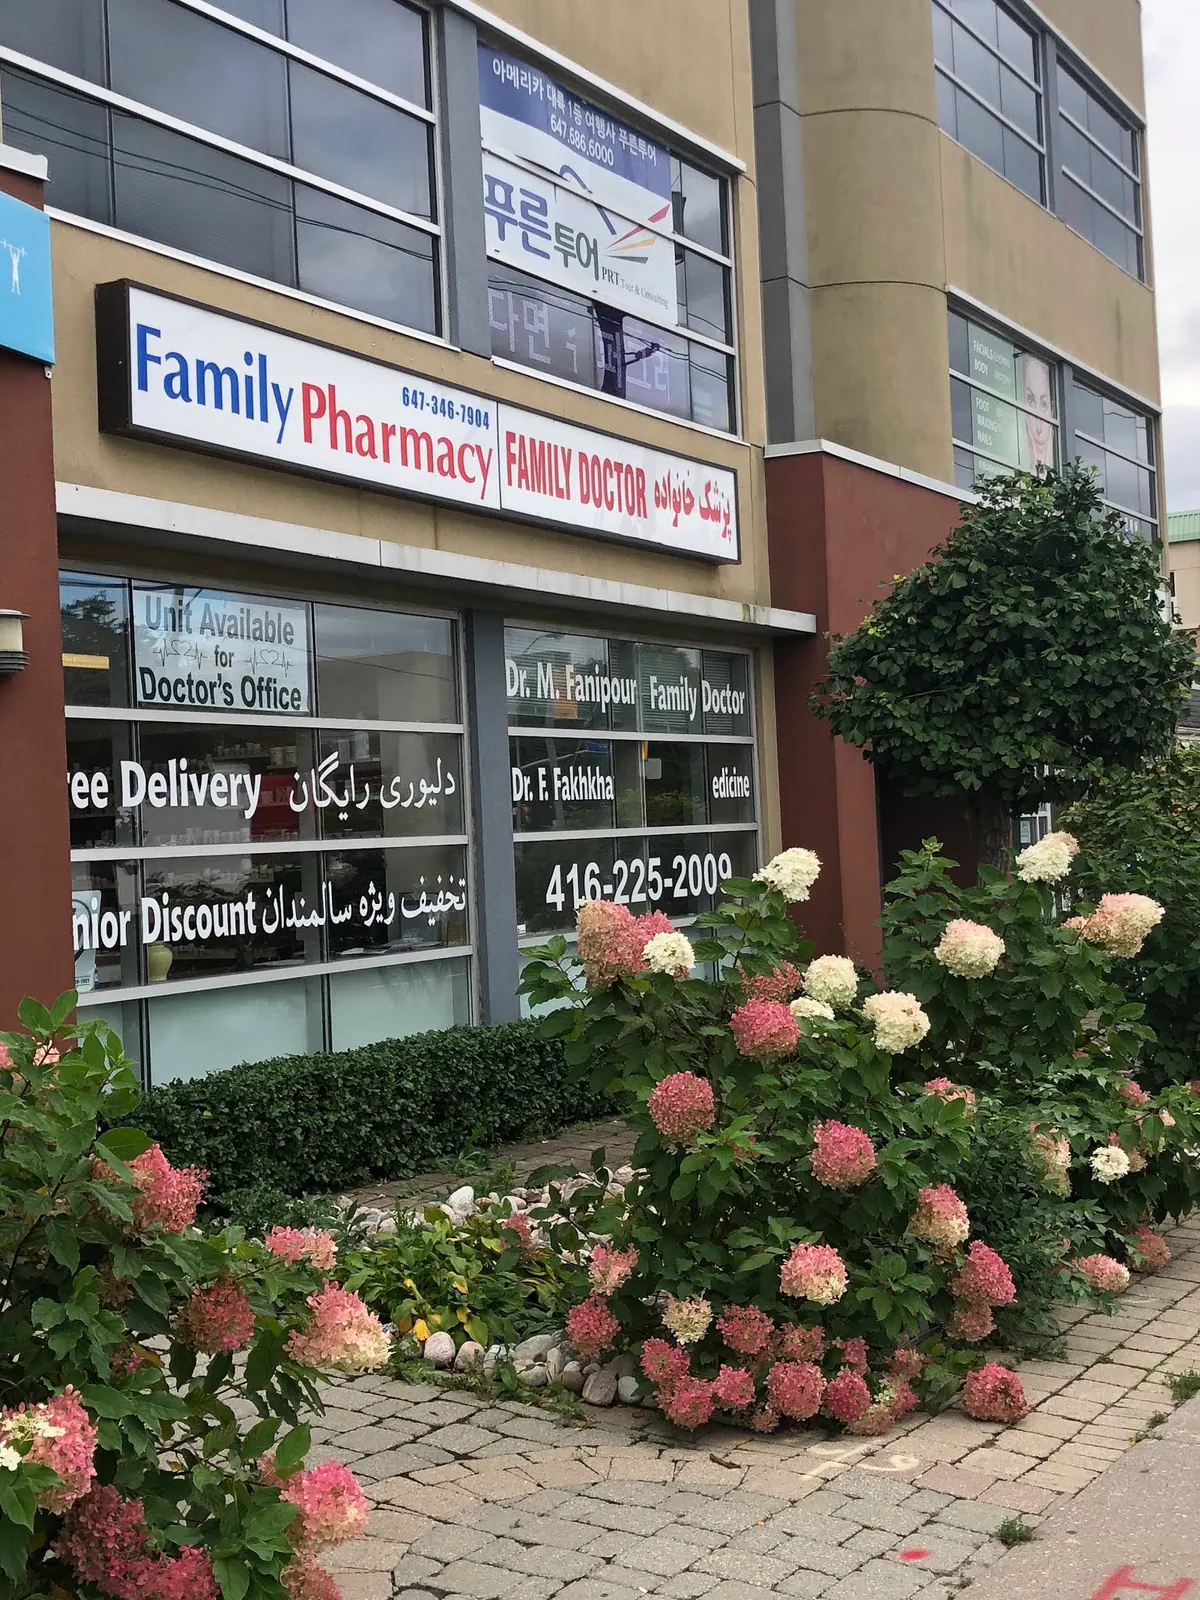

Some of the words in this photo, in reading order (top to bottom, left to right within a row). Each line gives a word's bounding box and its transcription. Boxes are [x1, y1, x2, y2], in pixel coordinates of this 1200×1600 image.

[493, 58, 544, 101] 아메리카
[546, 83, 565, 115] 대륙
[568, 100, 583, 127] 1등
[586, 113, 616, 143] 여행사
[619, 128, 657, 167] 푸른투어
[551, 114, 615, 167] 647.686.6000
[602, 266, 620, 285] PRT
[136, 322, 294, 444] Family
[302, 382, 493, 500] Pharmacy
[401, 386, 490, 431] 647-346-7904
[505, 430, 572, 501] FAMILY
[578, 451, 648, 519] DOCTOR
[654, 468, 695, 528] خانواده
[698, 479, 732, 543] پزشک
[146, 595, 193, 634] Unit
[200, 602, 295, 645] Available
[214, 644, 235, 668] for
[138, 666, 234, 706] Doctor's
[240, 675, 302, 711] Office
[505, 658, 531, 699] Dr.
[537, 661, 559, 701] M.
[566, 664, 637, 713] Fanipour
[649, 674, 698, 722] Family
[701, 679, 746, 715] Doctor
[67, 771, 109, 809] ee
[120, 757, 262, 820] Delivery
[289, 750, 370, 821] رایگان
[380, 757, 456, 809] دلیوری
[511, 766, 533, 802] Dr.
[538, 766, 549, 802] F.
[553, 765, 615, 802] Fakhkha
[712, 766, 751, 799] edicine
[262, 880, 352, 934] سالمندان
[401, 875, 466, 927] تخفیف
[545, 852, 733, 912] 416-225-2009
[73, 896, 131, 951] nior
[142, 891, 256, 945] Discount
